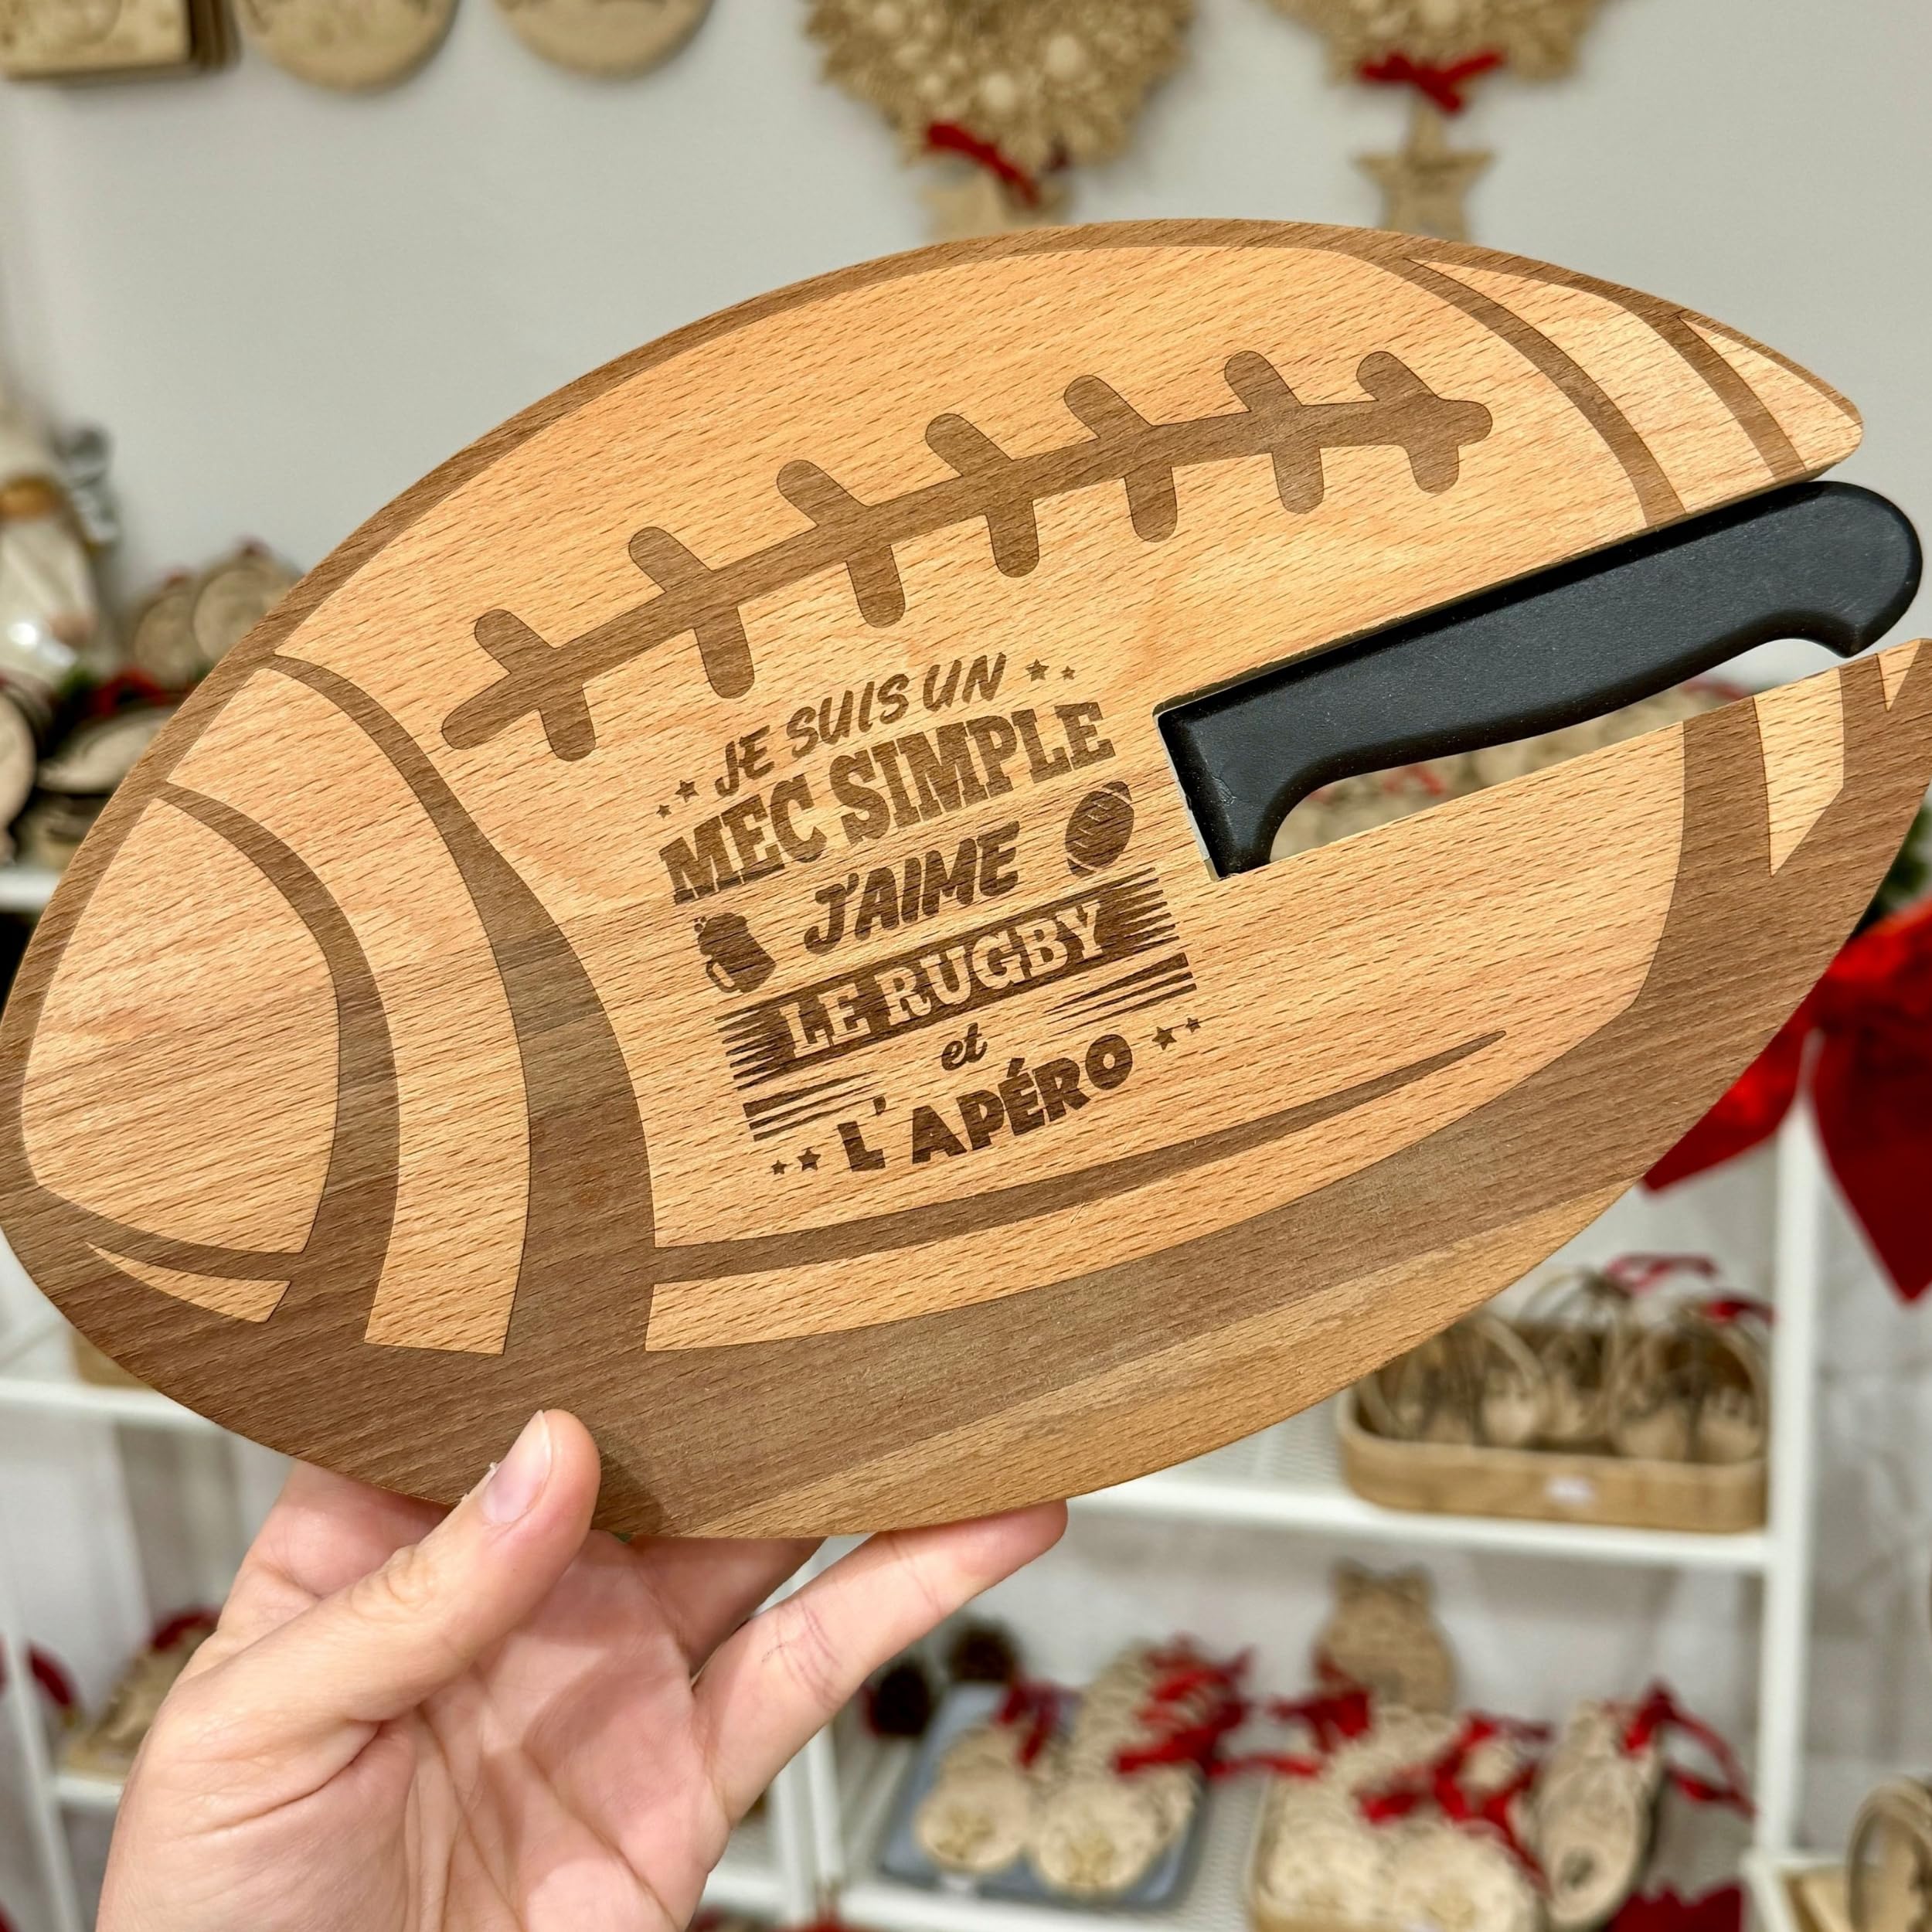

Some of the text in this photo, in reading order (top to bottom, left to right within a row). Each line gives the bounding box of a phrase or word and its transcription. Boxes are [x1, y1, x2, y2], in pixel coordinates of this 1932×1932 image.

[715, 652, 1006, 797] JE SUIS UN
[658, 701, 1116, 906] MEC SIMPLE
[804, 821, 1020, 955] J'AIME
[778, 900, 1105, 1056] LE RUGBY
[940, 1022, 988, 1071] et
